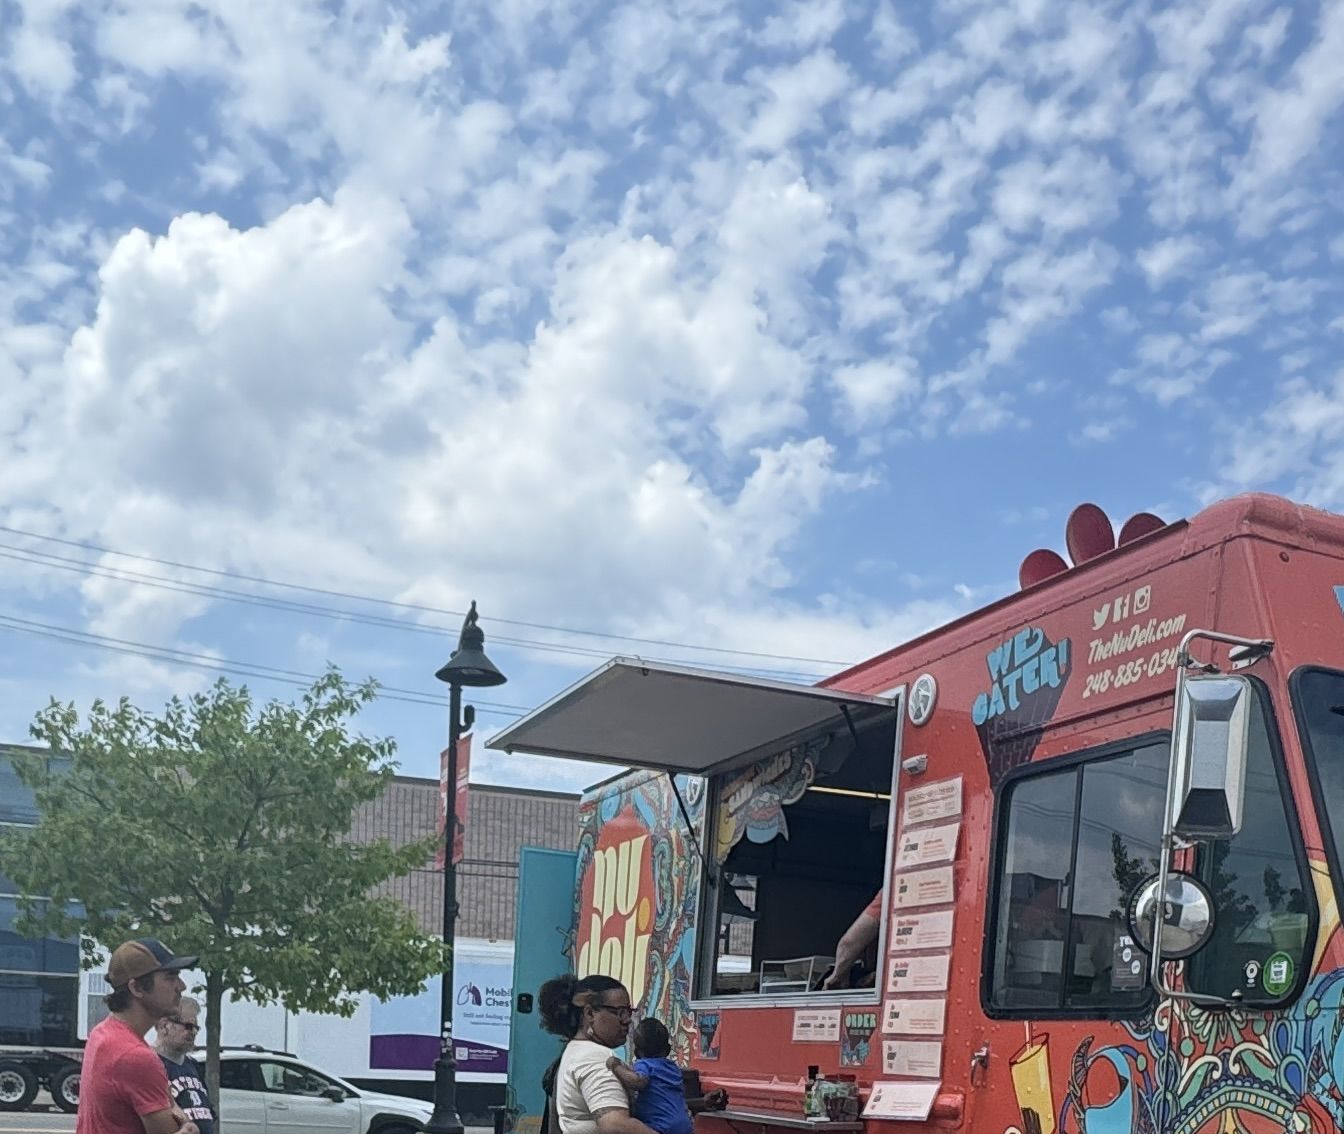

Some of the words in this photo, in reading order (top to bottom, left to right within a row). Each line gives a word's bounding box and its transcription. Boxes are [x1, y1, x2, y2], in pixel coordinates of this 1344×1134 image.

[987, 627, 1043, 681] WE
[1087, 614, 1187, 665] TheNuDeli.com
[485, 997, 510, 1008] Ches
[845, 1013, 877, 1028] ORDER
